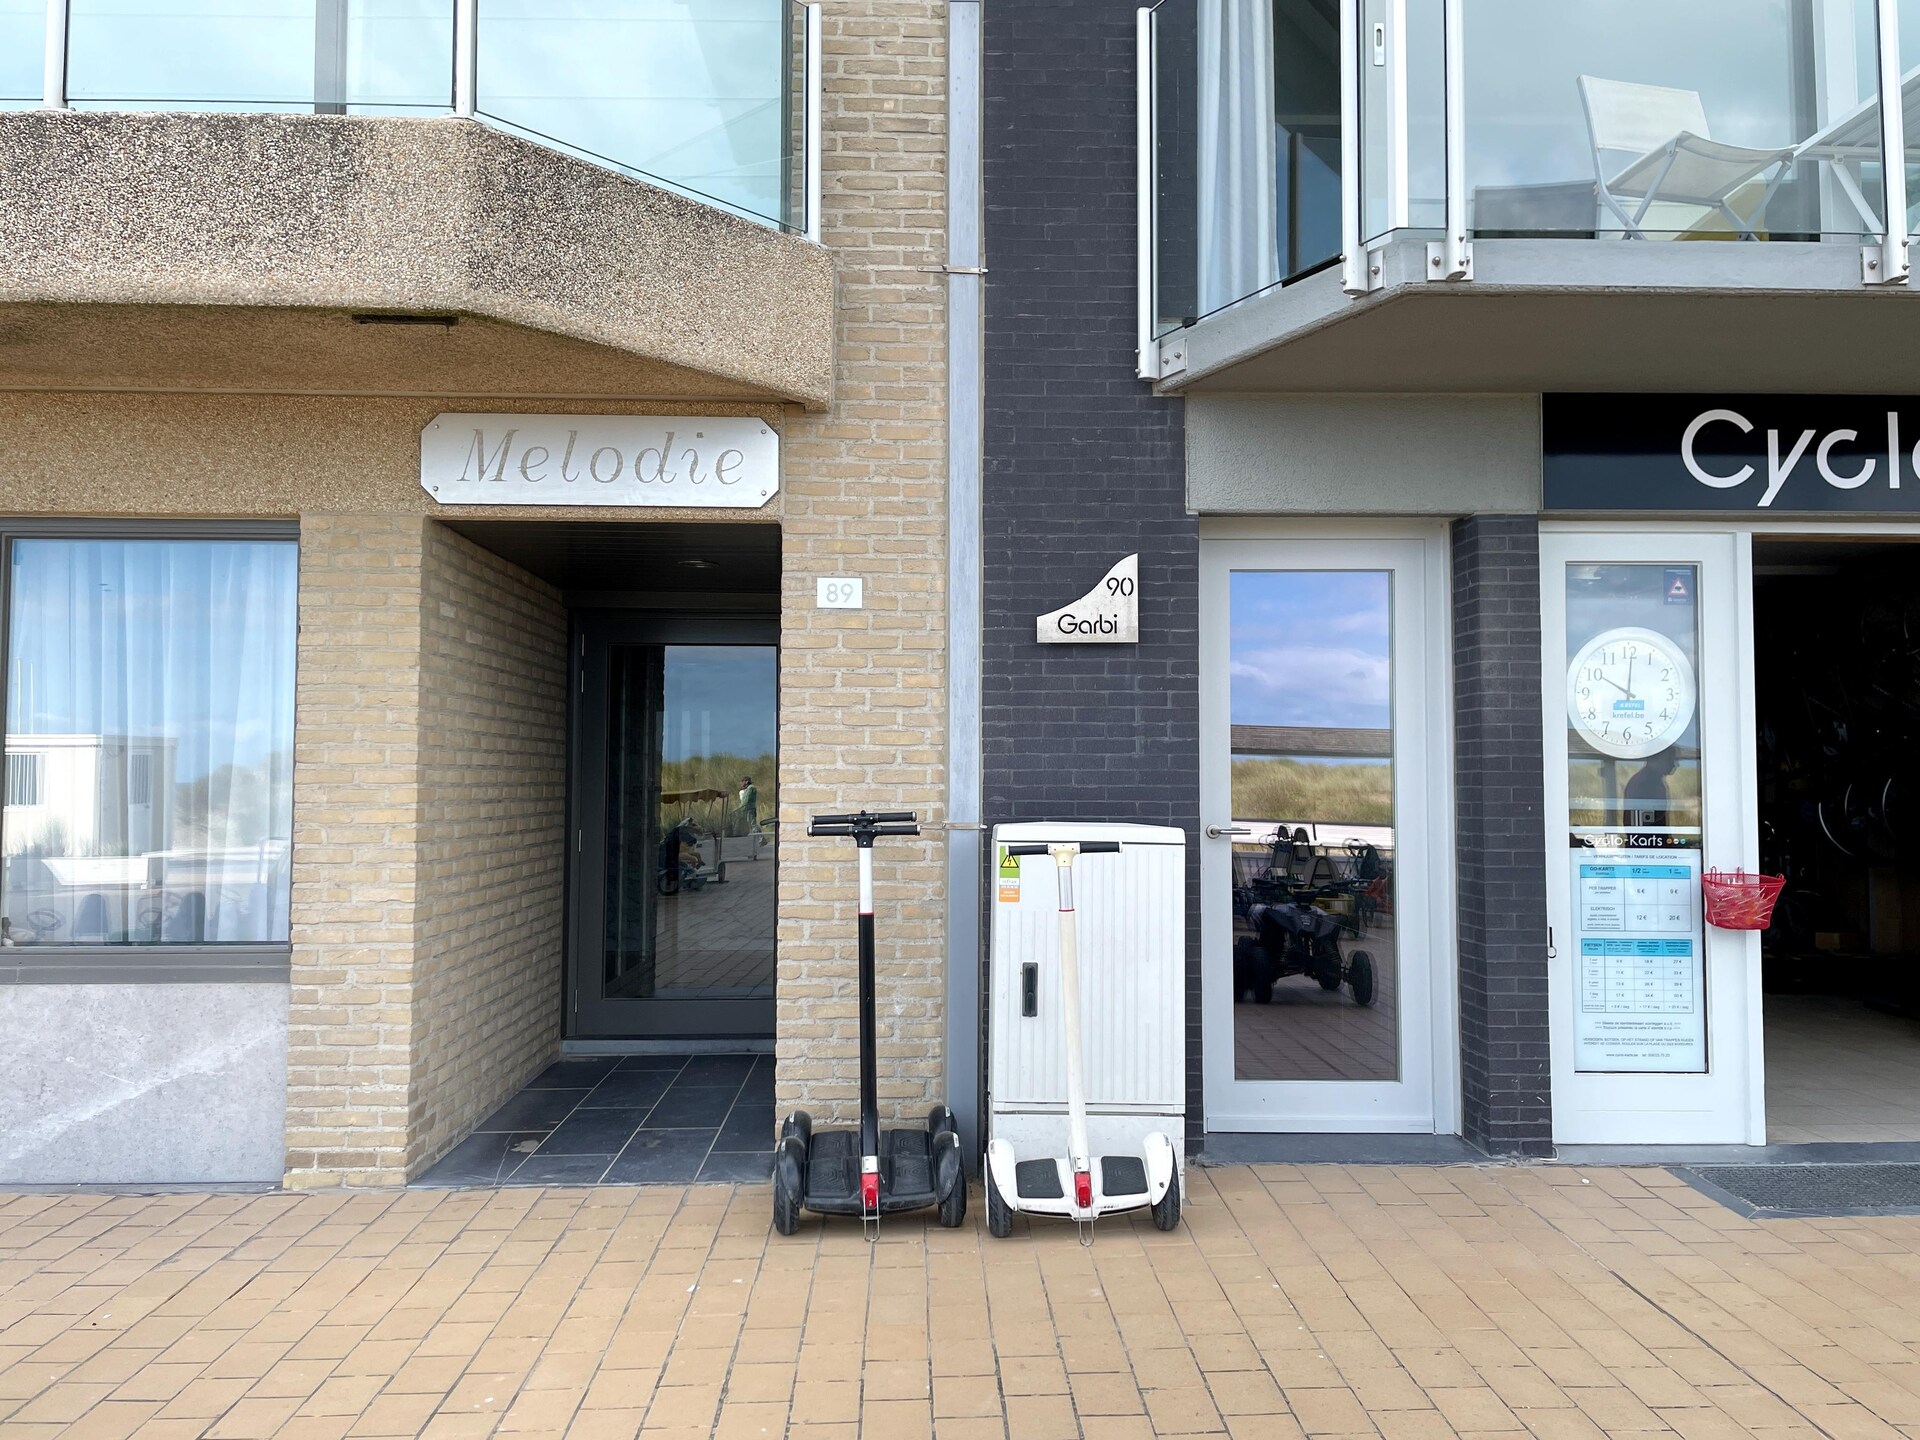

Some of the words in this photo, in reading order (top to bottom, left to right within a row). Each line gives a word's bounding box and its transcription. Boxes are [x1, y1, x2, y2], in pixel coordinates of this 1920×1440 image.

[455, 427, 745, 486] Melodie
[1681, 408, 1920, 507] Cycl
[825, 582, 854, 604] 89
[1106, 576, 1135, 597] 90
[1057, 613, 1119, 635] Garbi
[1602, 652, 1615, 666] 11
[1622, 646, 1637, 660] 12
[1647, 652, 1652, 666] 1
[1586, 668, 1603, 682] 10
[1660, 668, 1670, 682] 2
[1581, 687, 1590, 700] 9
[1666, 687, 1674, 702] 3
[1588, 707, 1596, 720] 8
[1612, 711, 1645, 719] krefel.be
[1659, 707, 1669, 721] 4
[1602, 720, 1610, 735] 7
[1622, 726, 1632, 740] 6
[1644, 721, 1653, 736] 5
